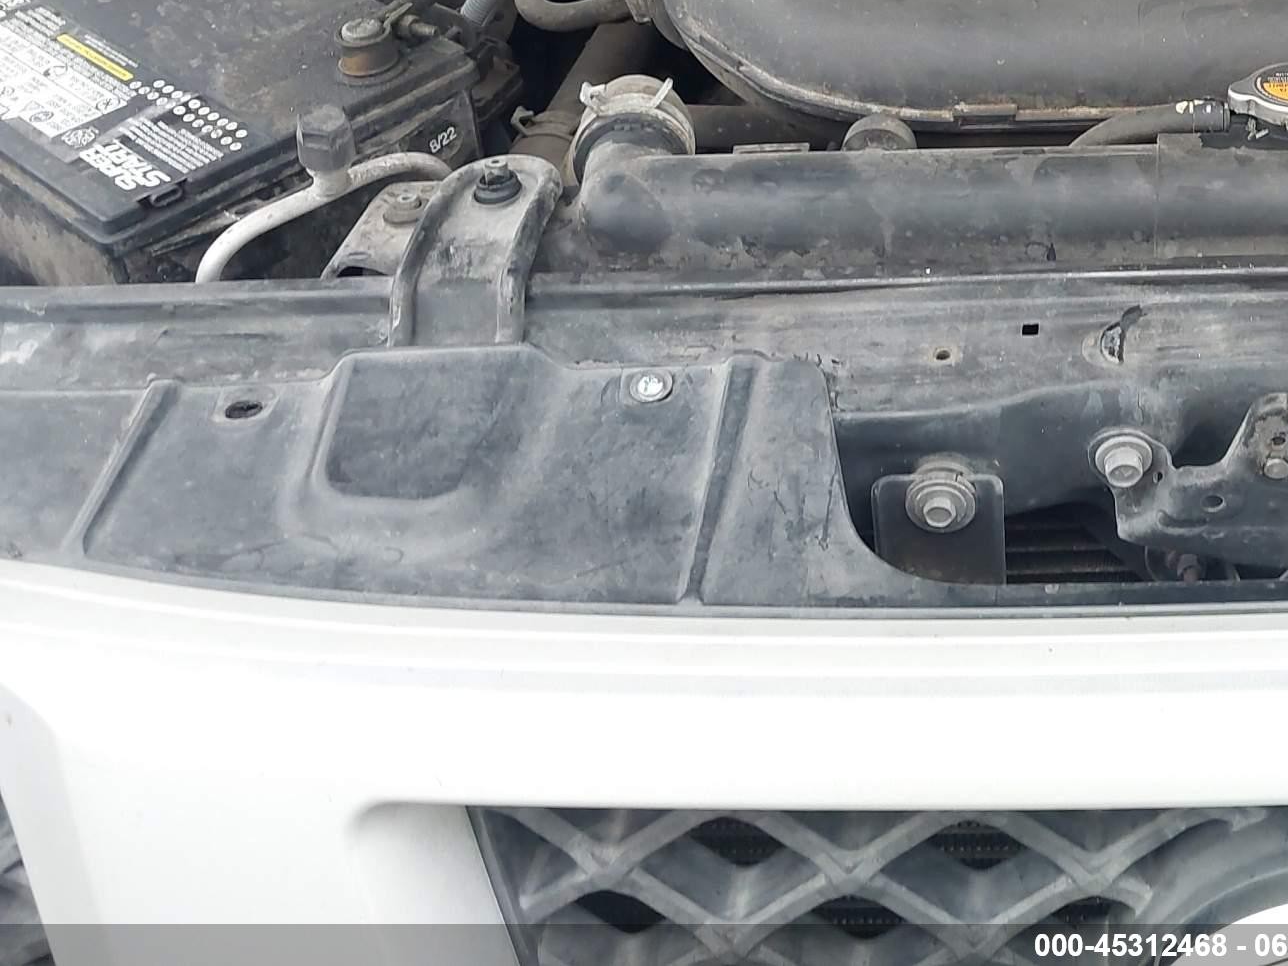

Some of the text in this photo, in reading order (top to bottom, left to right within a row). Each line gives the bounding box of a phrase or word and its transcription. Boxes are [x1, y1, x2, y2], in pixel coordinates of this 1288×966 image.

[429, 126, 457, 154] 8/22
[79, 146, 137, 191] SUPER
[93, 141, 172, 188] START
